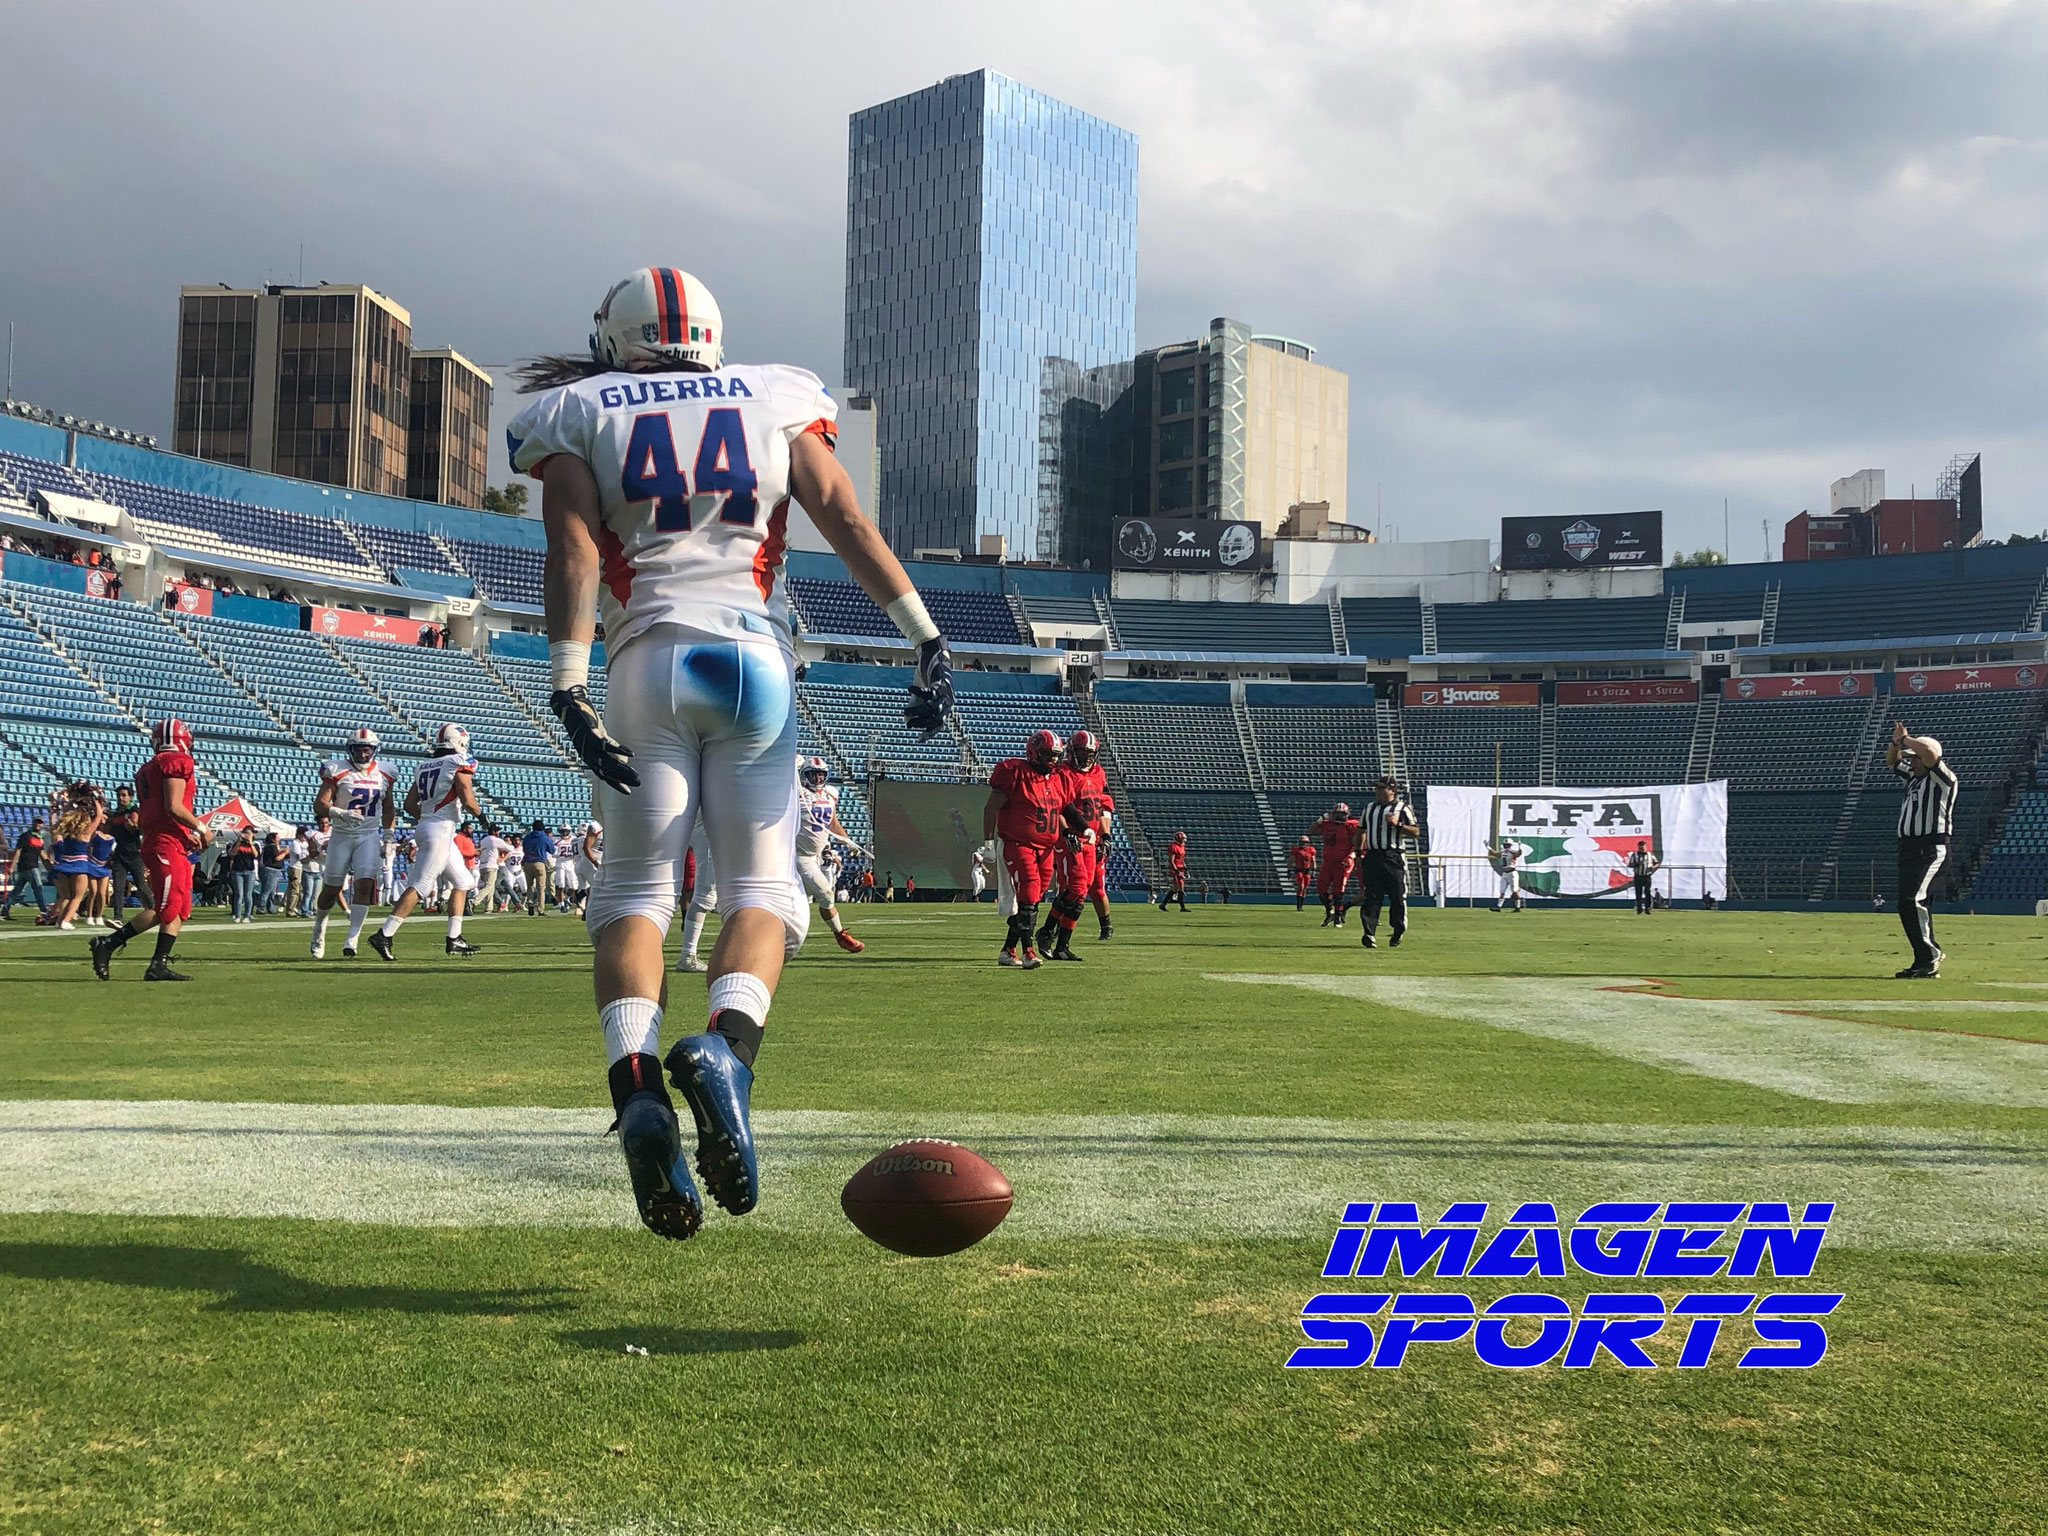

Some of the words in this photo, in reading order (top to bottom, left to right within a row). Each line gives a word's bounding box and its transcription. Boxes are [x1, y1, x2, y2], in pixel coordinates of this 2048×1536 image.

[600, 376, 753, 408] GUERRA
[621, 407, 758, 533] 44
[1163, 547, 1211, 558] XENITH
[1608, 550, 1647, 561] WEST
[452, 600, 471, 613] 22
[363, 629, 396, 641] XENITH
[1071, 653, 1089, 663] 20
[1377, 658, 1391, 666] 19
[1711, 653, 1725, 663] 18
[1955, 681, 1992, 690] XENITH
[1441, 687, 1500, 705] Yavaros
[1586, 689, 1599, 697] LA
[1639, 688, 1652, 696] LA
[1781, 689, 1816, 697] XENITH
[418, 768, 441, 802] 97
[1035, 806, 1059, 835] 50
[1507, 803, 1644, 827] LFA
[1508, 827, 1642, 836] MEXICO
[872, 1153, 956, 1177] Wilson
